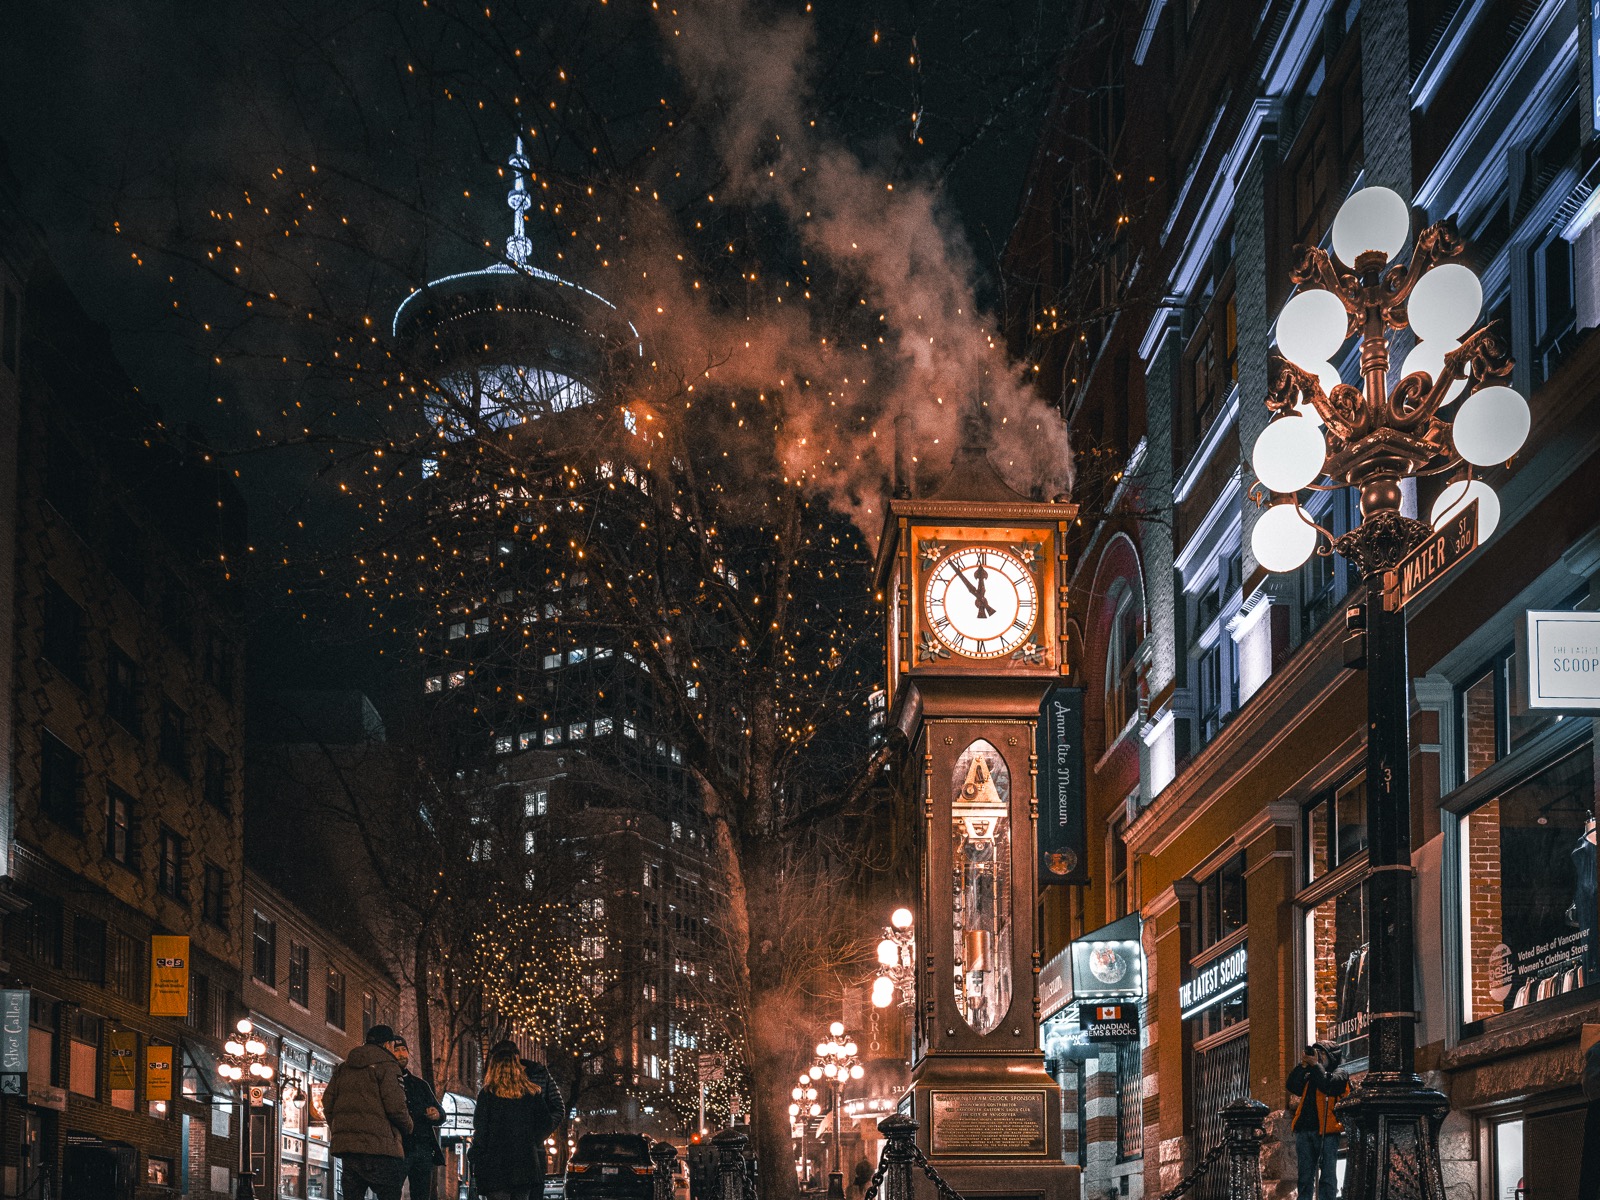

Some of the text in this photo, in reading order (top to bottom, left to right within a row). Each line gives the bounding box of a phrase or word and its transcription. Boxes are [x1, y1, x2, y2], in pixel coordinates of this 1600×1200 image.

[1458, 516, 1467, 535] ST
[1455, 530, 1471, 554] 300
[1403, 536, 1446, 595] WATER
[1553, 658, 1599, 673] SCOOP
[1057, 768, 1070, 826] Museum
[1517, 947, 1535, 961] Voted
[1536, 943, 1550, 955] Best
[1550, 938, 1557, 949] of
[1557, 928, 1590, 947] Vancouver
[1517, 943, 1589, 976] Women's Clothing Store
[1179, 949, 1246, 1008] THE LATEST SCOOP
[870, 1004, 880, 1051] ORTO
[1089, 1023, 1130, 1031] CANADIAN
[1111, 1028, 1137, 1036] ROCKS
[1338, 1017, 1358, 1037] LATEST
[3, 1036, 21, 1068] Silver
